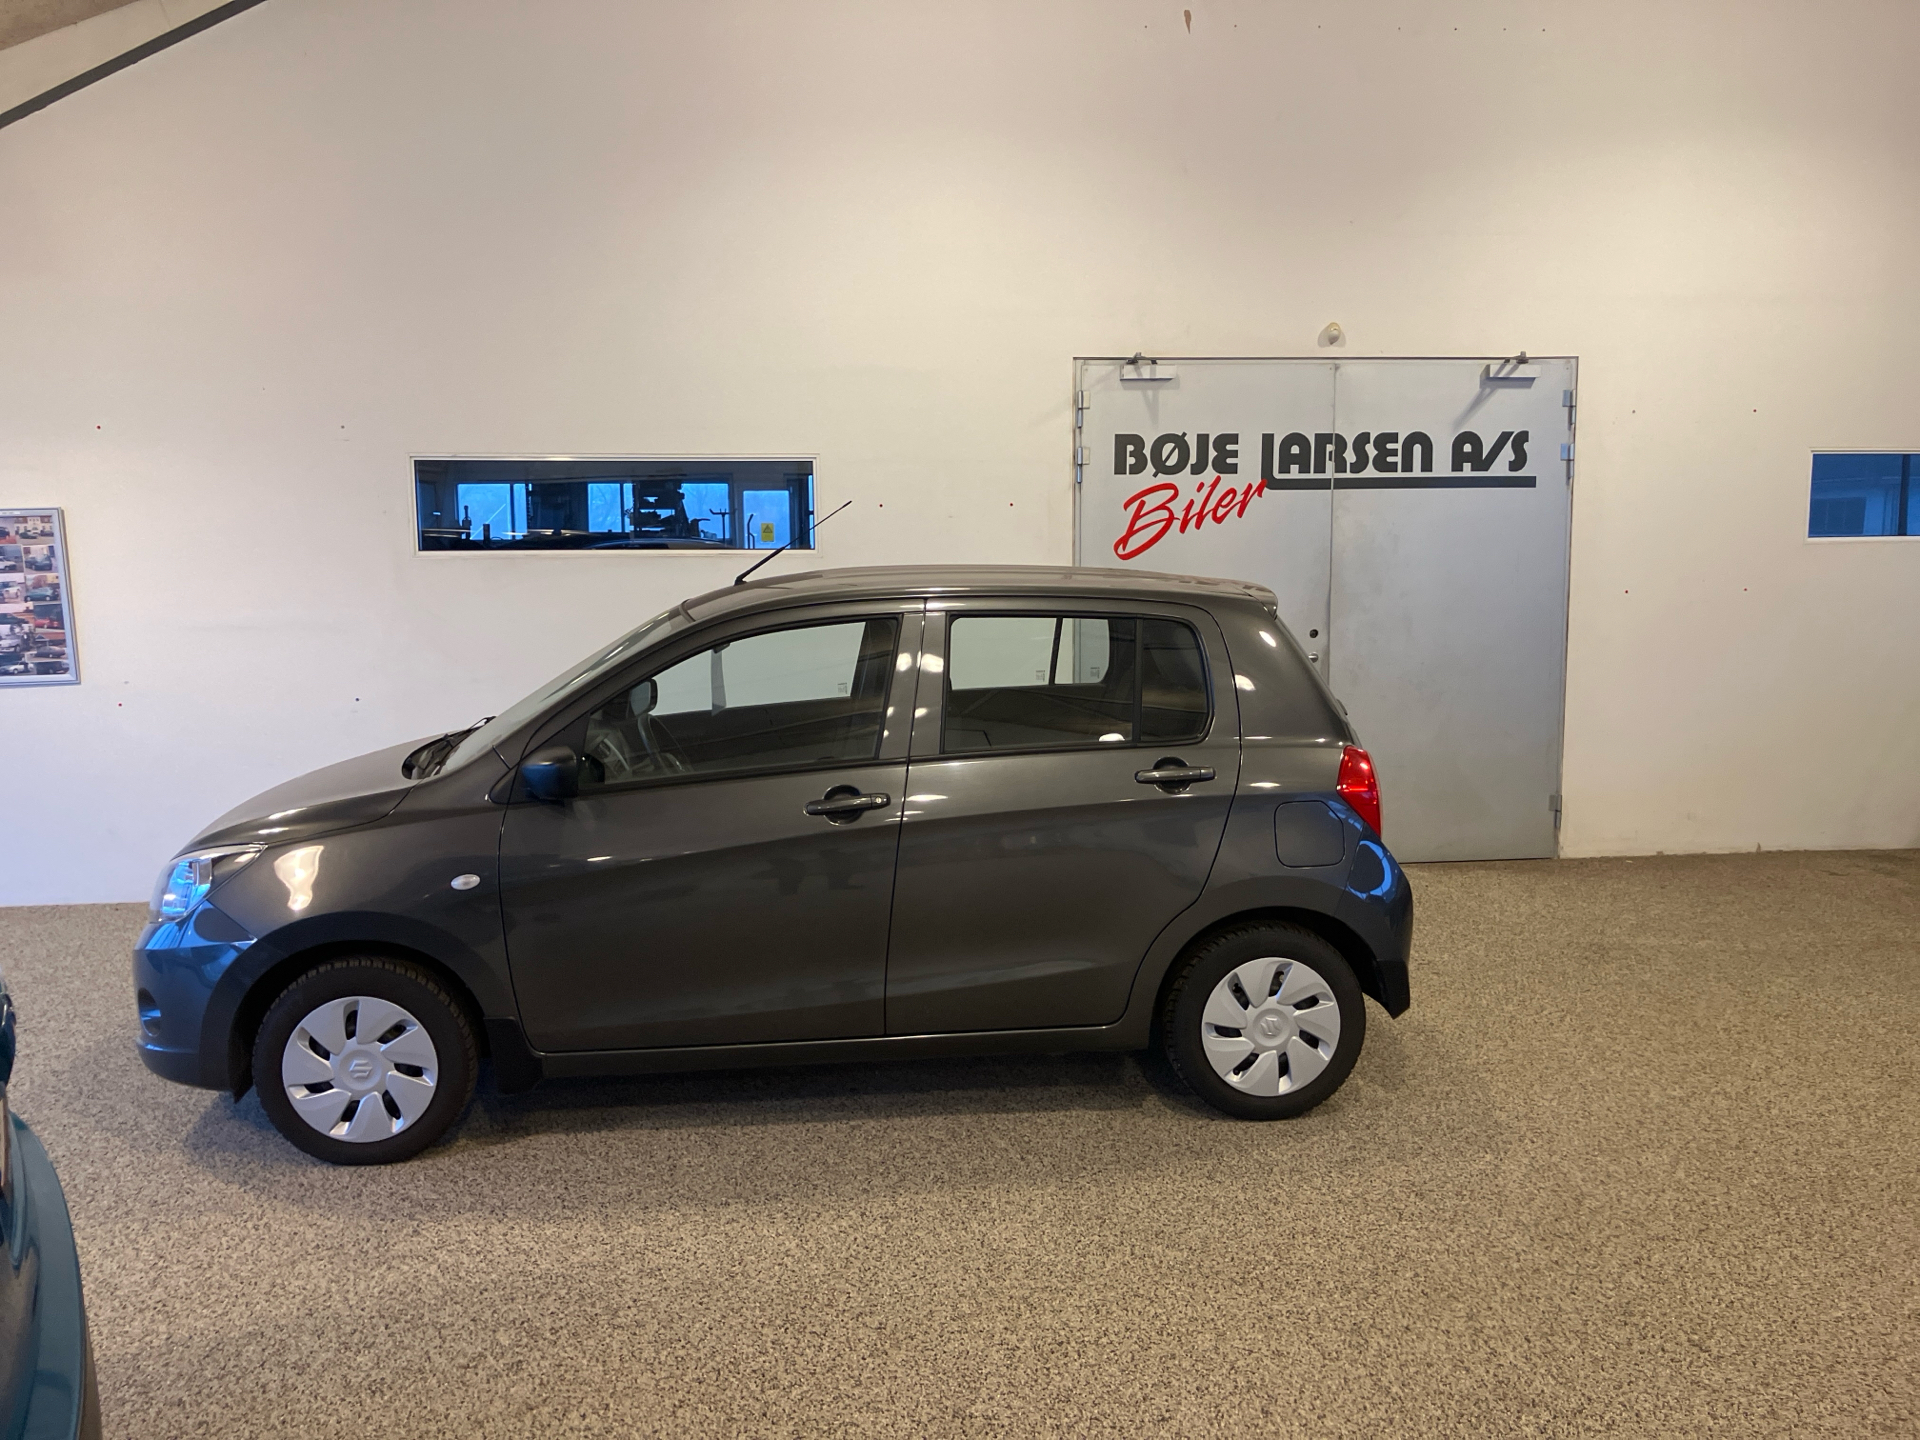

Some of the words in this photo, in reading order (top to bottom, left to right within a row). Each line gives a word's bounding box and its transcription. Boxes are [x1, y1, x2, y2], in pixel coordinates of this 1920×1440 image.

[1113, 432, 1239, 478] BØJE
[1261, 431, 1434, 490] LARSEN
[1450, 430, 1530, 473] A/S
[1113, 475, 1268, 561] Biler
